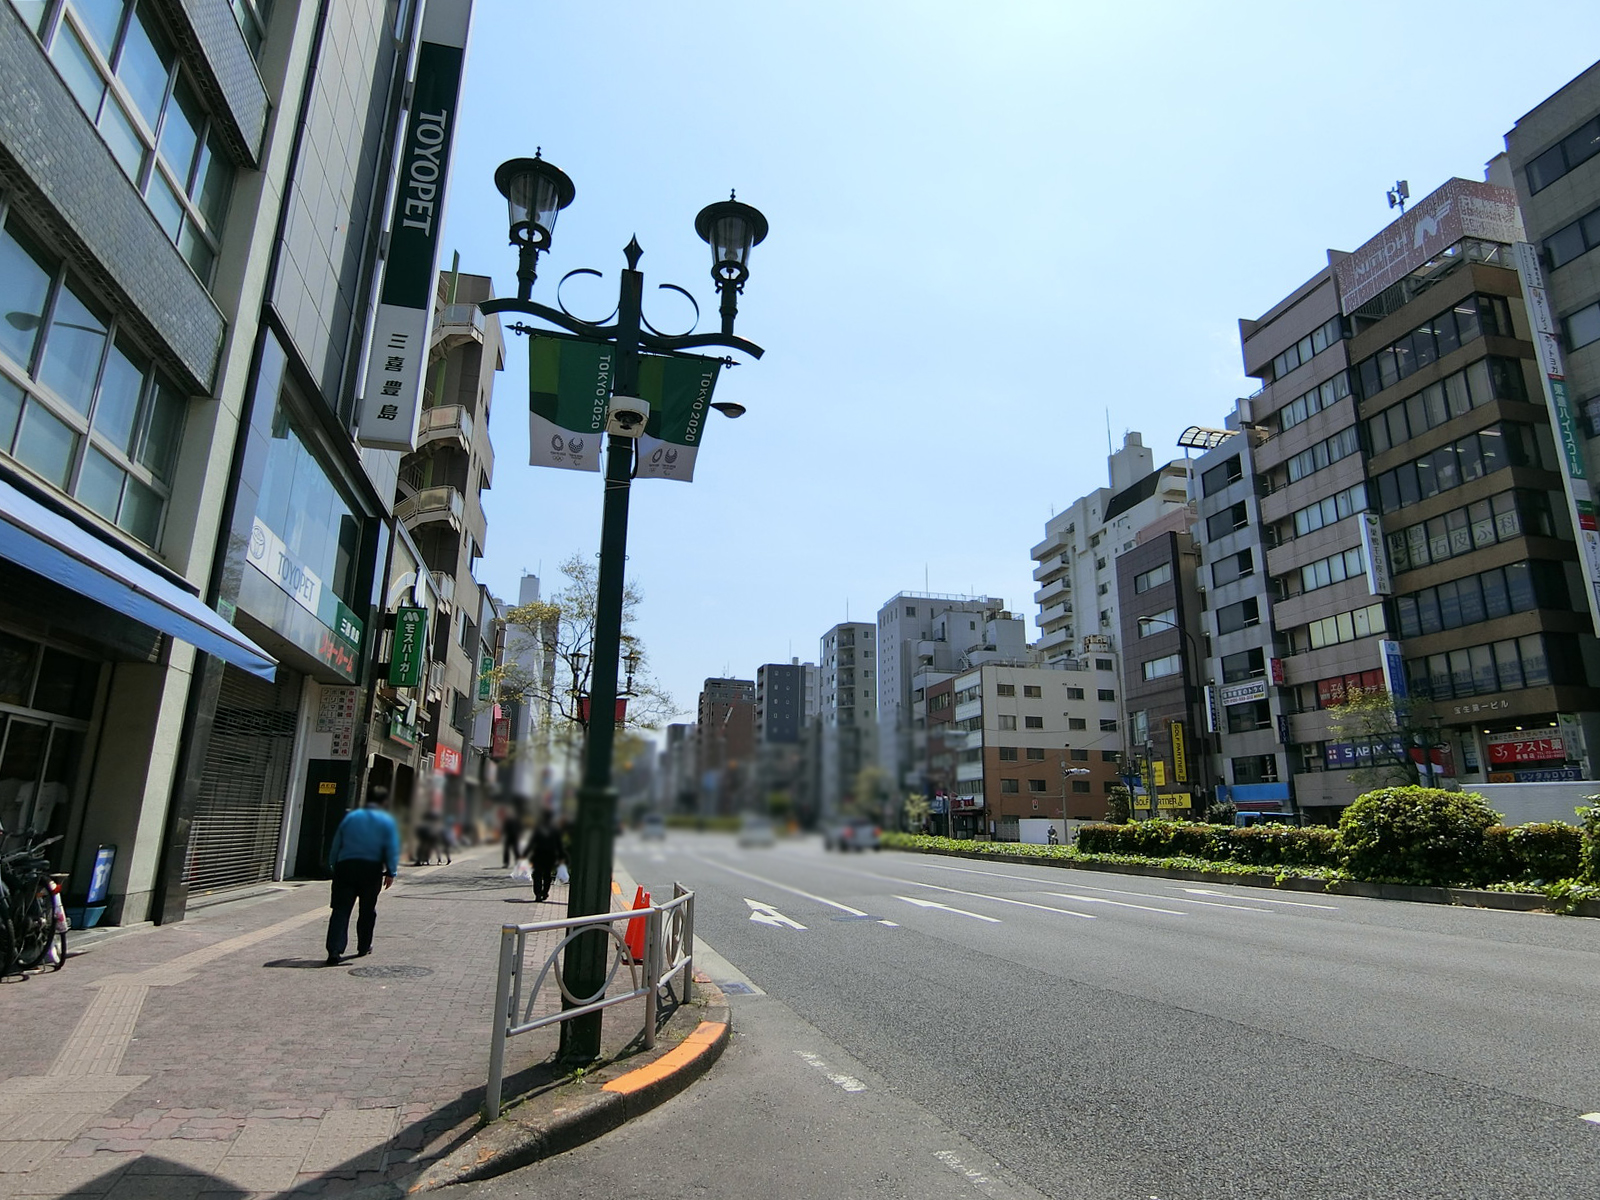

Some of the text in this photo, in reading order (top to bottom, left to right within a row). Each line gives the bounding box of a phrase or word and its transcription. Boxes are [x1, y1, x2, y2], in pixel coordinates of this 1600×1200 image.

[402, 108, 448, 237] TOYOPET
[591, 354, 611, 430] TOKYO 2020
[684, 371, 713, 442] TOKYO 2020
[1553, 383, 1582, 476] 東進ハイスクール
[278, 551, 316, 603] TOYOPET
[399, 623, 415, 682] モスバーガー
[1520, 770, 1575, 780] レンタルDVD
